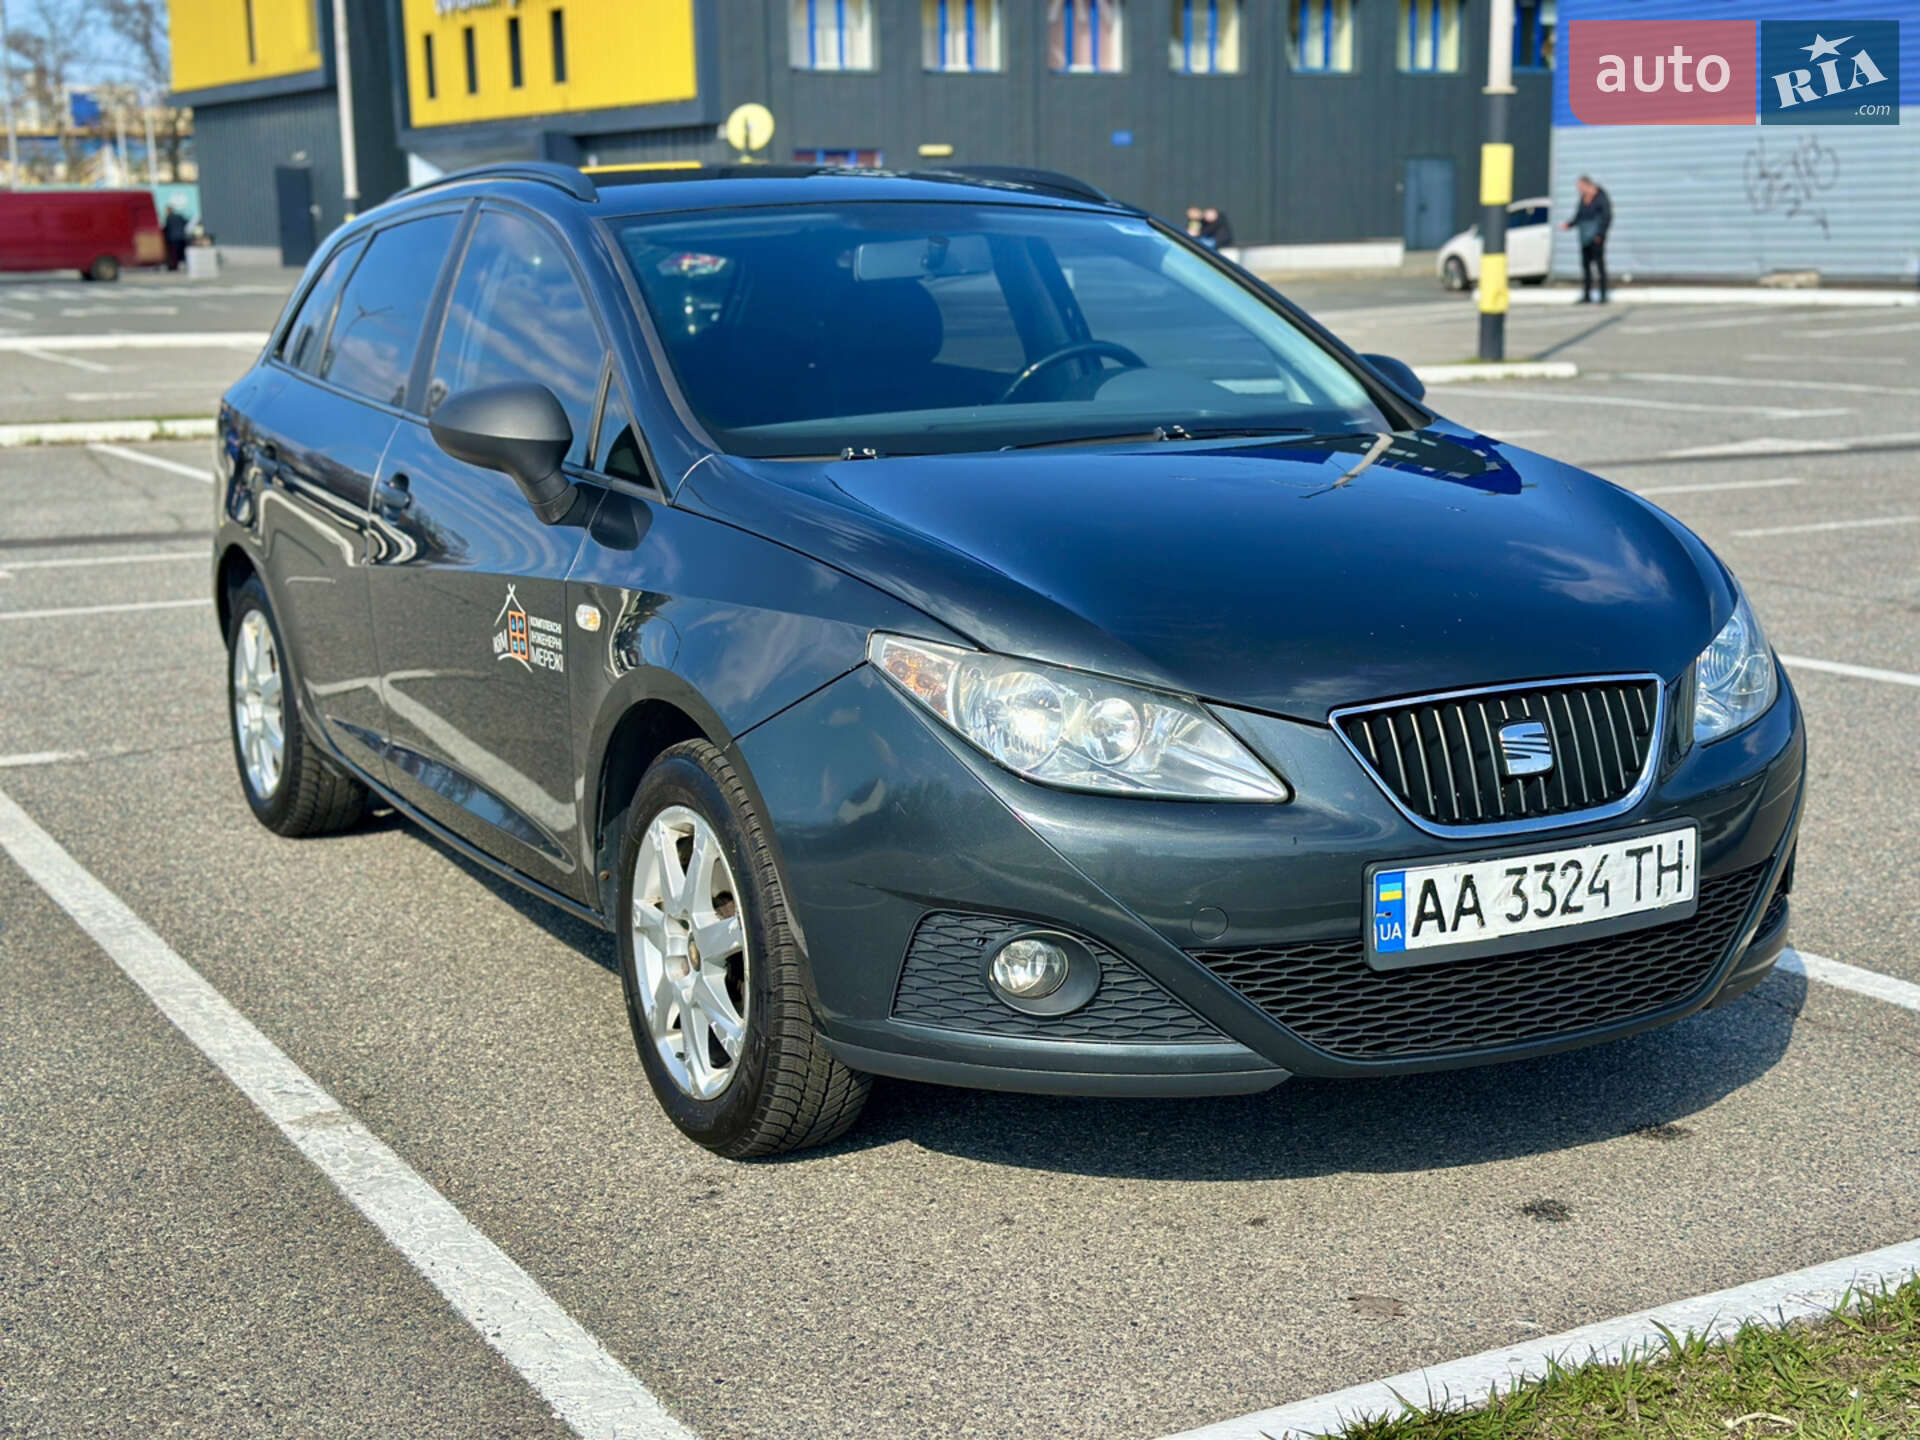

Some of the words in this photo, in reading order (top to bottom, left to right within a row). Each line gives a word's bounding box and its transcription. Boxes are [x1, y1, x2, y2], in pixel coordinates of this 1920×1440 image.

[1411, 874, 1486, 937] AA
[1505, 854, 1610, 922] 3324
[1625, 839, 1685, 903] TH
[1379, 922, 1403, 941] UA
